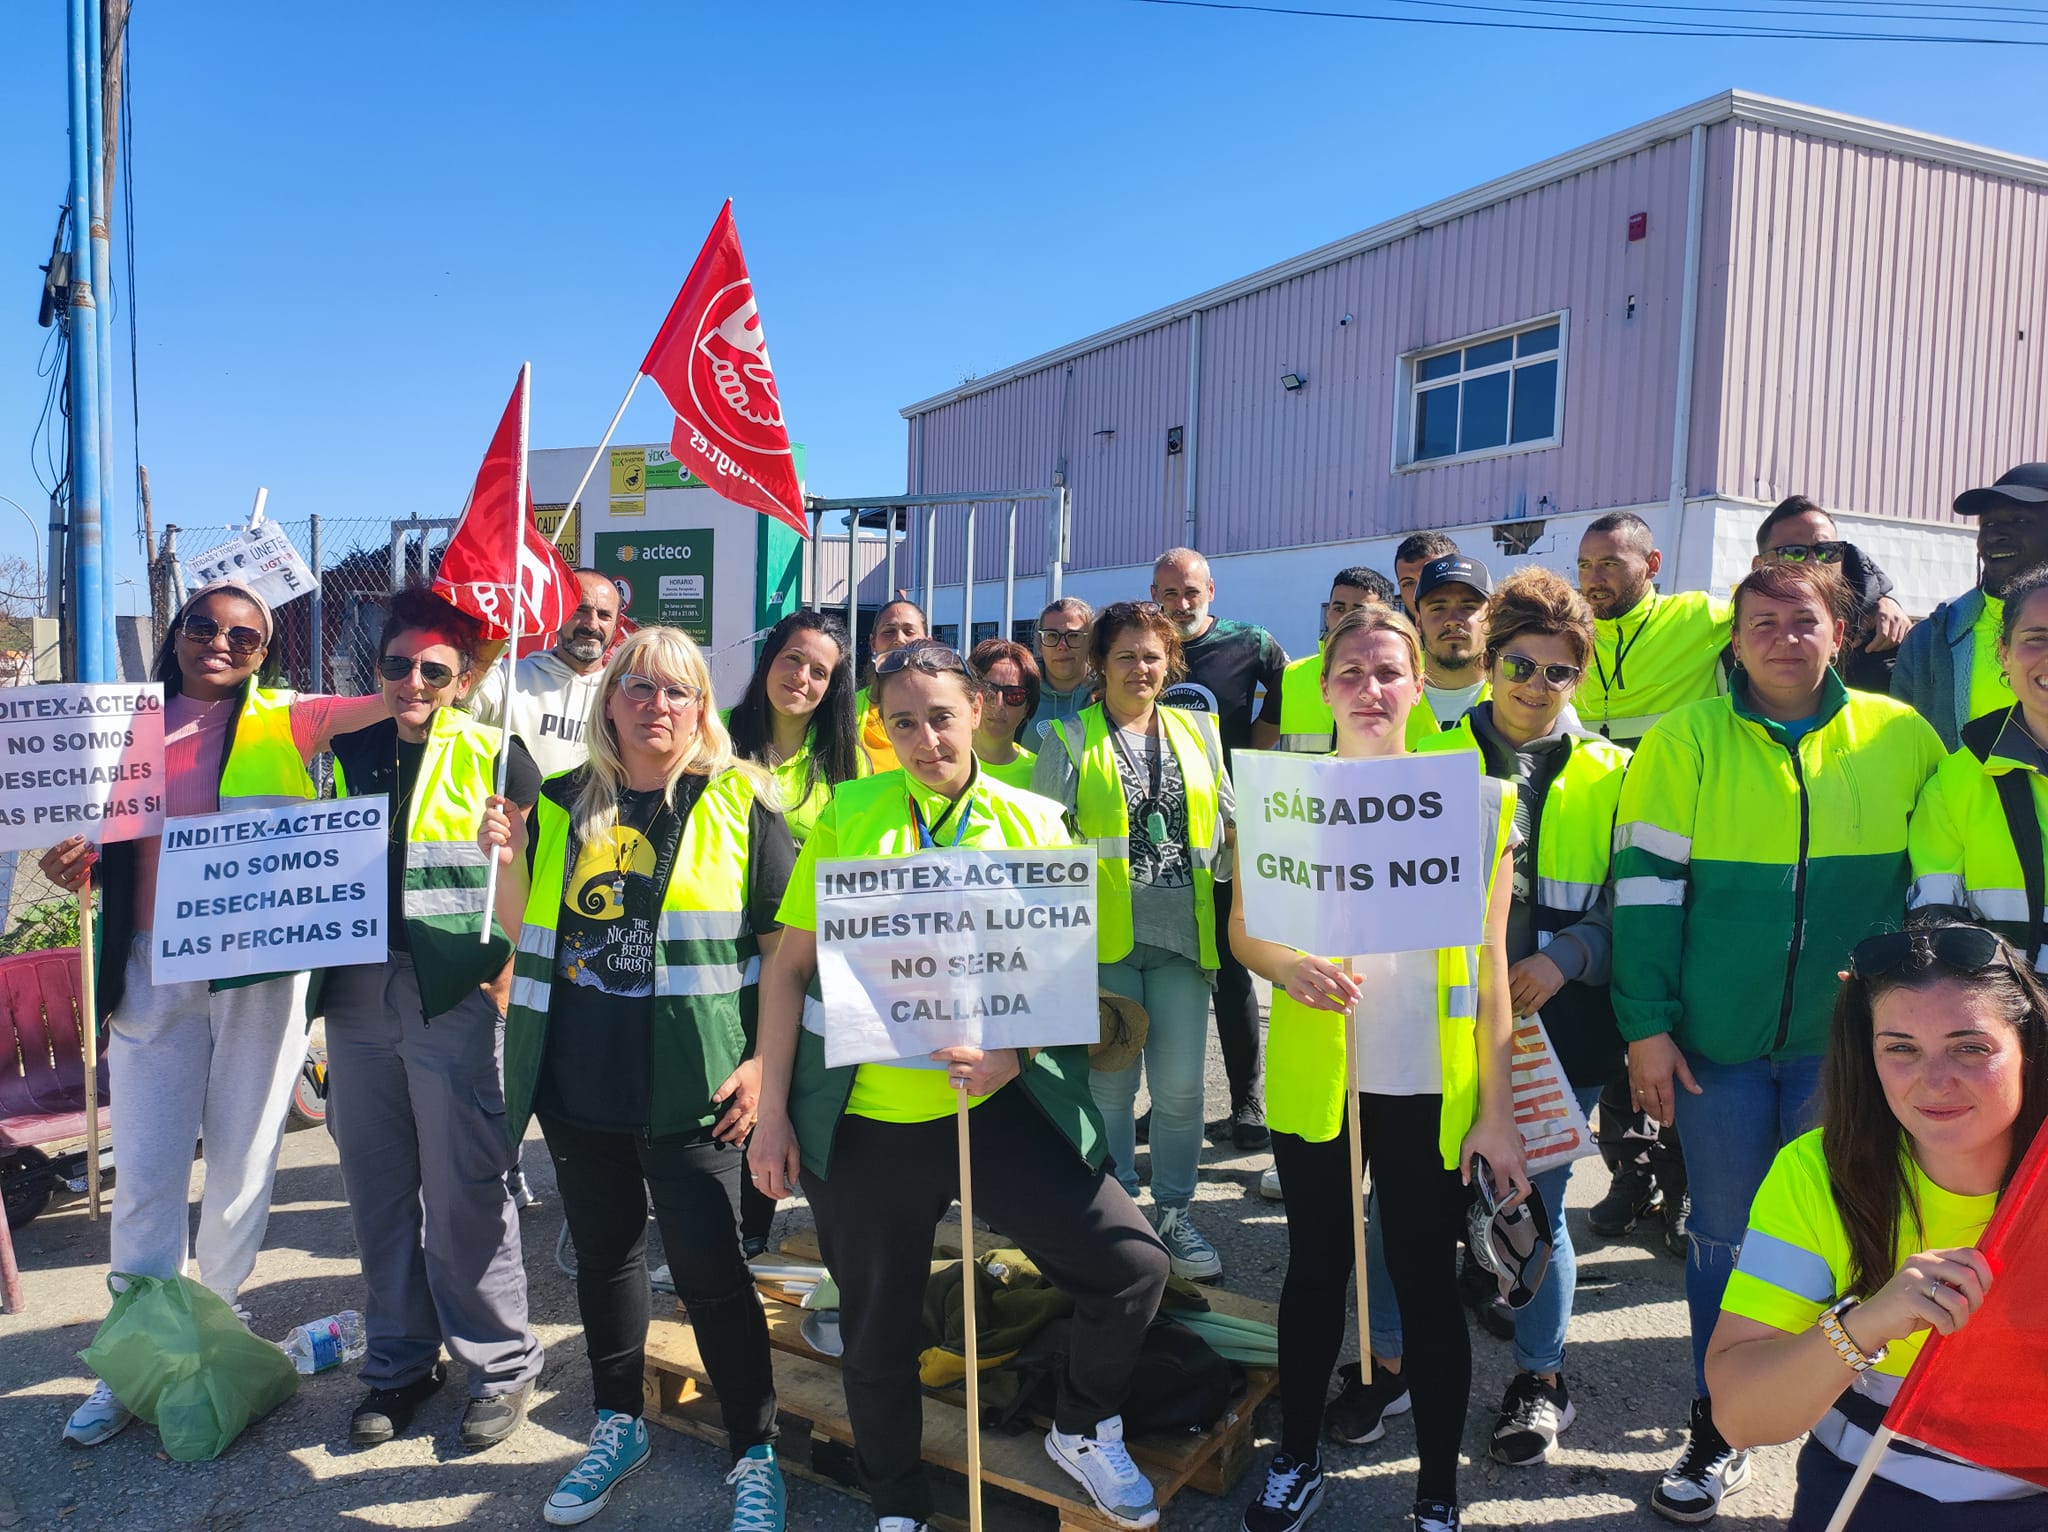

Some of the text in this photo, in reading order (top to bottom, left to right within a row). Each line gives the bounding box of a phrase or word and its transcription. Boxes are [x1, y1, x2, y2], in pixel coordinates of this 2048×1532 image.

[191, 554, 215, 569] TODAS
[249, 536, 287, 561] ÚNETE
[642, 544, 691, 560] acteco
[260, 556, 283, 573] UGT
[7, 730, 135, 755] NO SOMOS
[0, 762, 152, 790] ESECHABLES
[34, 798, 139, 824] PERCHAS
[145, 795, 161, 812] SI
[1263, 788, 1443, 826] ¡SÁBADOS
[167, 808, 382, 849] INDITEX-ACTECO
[204, 849, 339, 881] NO SOMOS
[825, 862, 1090, 896] INDITEX-ACTECO
[1256, 853, 1461, 892] GRATIS NO!
[176, 882, 366, 920] DESECHABLES
[162, 918, 378, 958] LAS PERCHAS SI
[632, 917, 650, 930] THE
[824, 905, 1092, 942] NUESTRA LUCHA
[891, 946, 1028, 980] NO SERÁ
[891, 993, 1032, 1023] CALLADA
